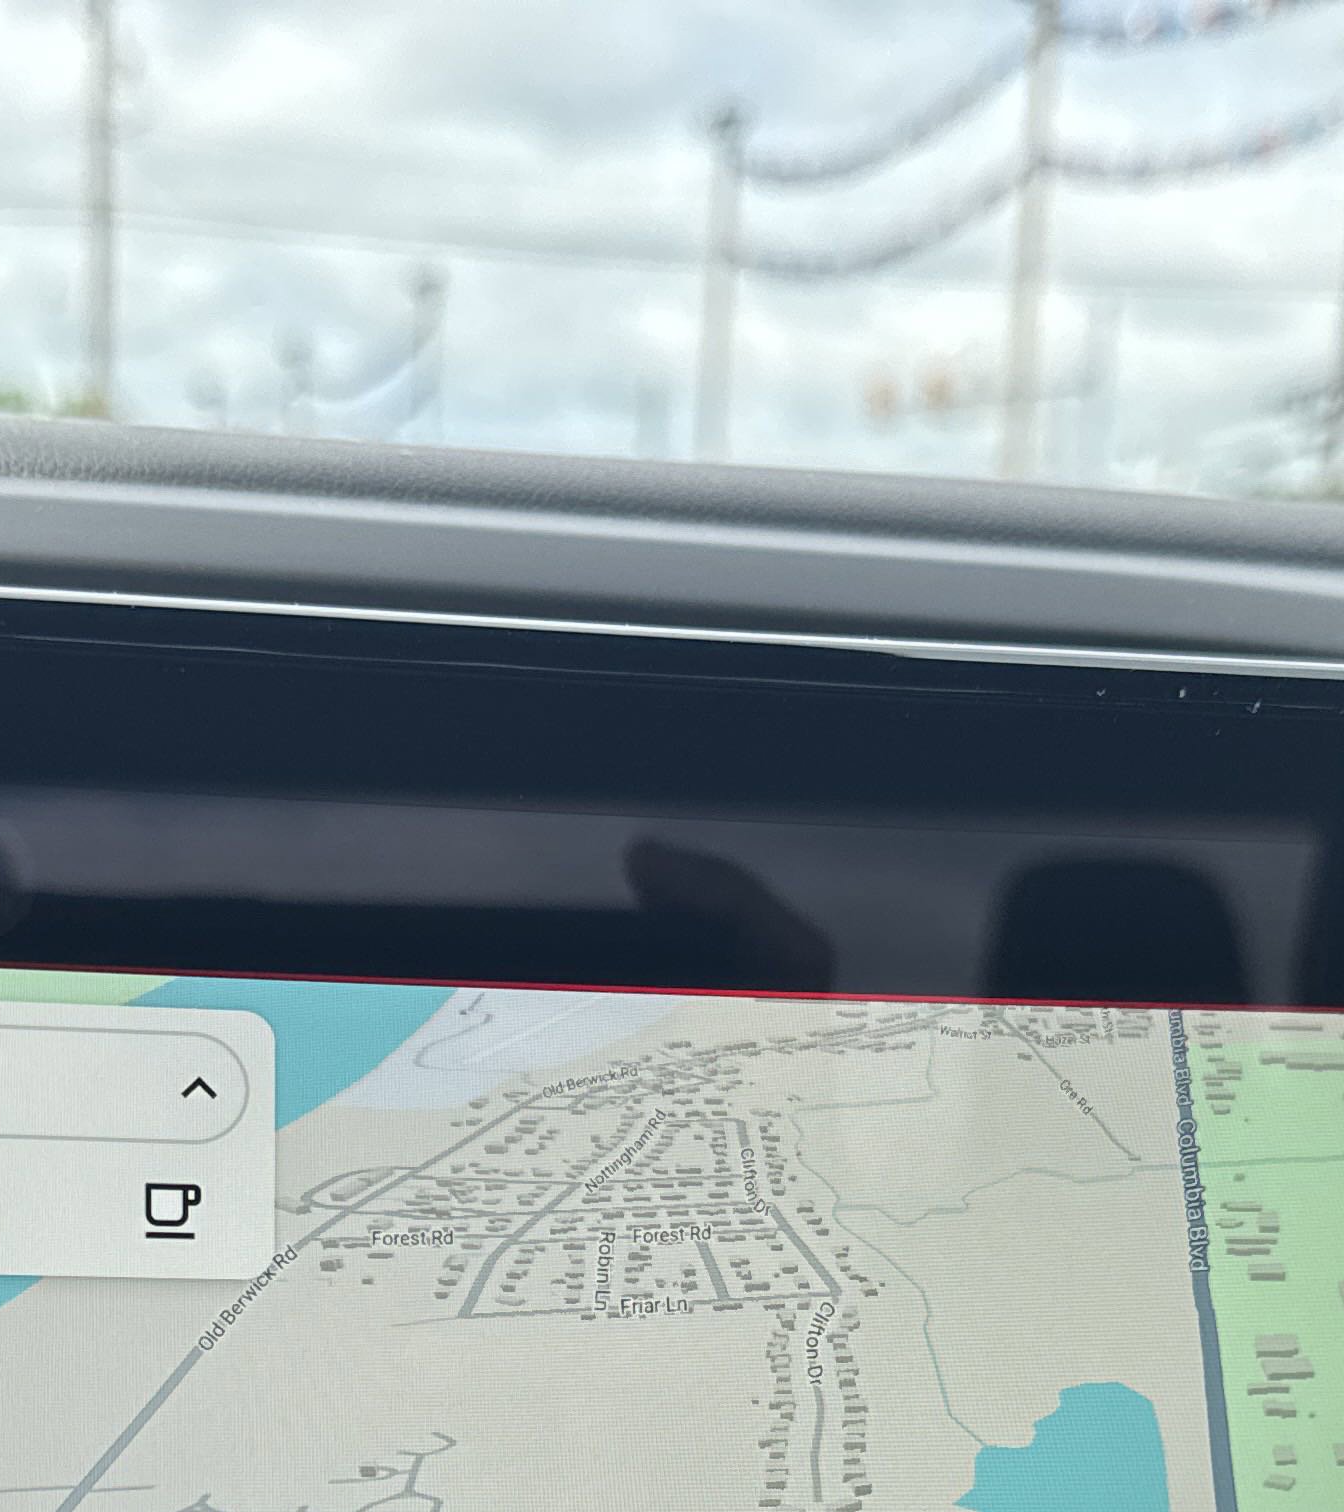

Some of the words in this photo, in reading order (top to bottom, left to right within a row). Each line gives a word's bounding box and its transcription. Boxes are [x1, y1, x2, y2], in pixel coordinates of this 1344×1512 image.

[542, 1082, 565, 1099] Old
[565, 1069, 619, 1092] Berwick
[620, 1065, 640, 1081] Rd
[1175, 1068, 1193, 1107] Blvd
[1076, 1096, 1094, 1116] Rd
[584, 1126, 659, 1194] Nottingham
[648, 1107, 668, 1133] Rd
[1177, 1118, 1207, 1221] Columbia
[739, 1147, 760, 1203] Clifton
[751, 1199, 772, 1218] Dr
[371, 1228, 428, 1248] Forest
[432, 1228, 454, 1247] Rd
[632, 1226, 685, 1244] Forest
[689, 1224, 712, 1242] Rd
[1189, 1224, 1210, 1273] Blvd
[596, 1231, 617, 1287] Robin
[197, 1320, 226, 1351] Old
[218, 1268, 277, 1326] Berwick
[271, 1244, 298, 1270] Rd
[593, 1288, 609, 1312] Ln
[619, 1297, 661, 1316] Friar
[664, 1296, 689, 1314] Ln
[805, 1300, 836, 1362] Clifton
[807, 1364, 824, 1387] Dr
